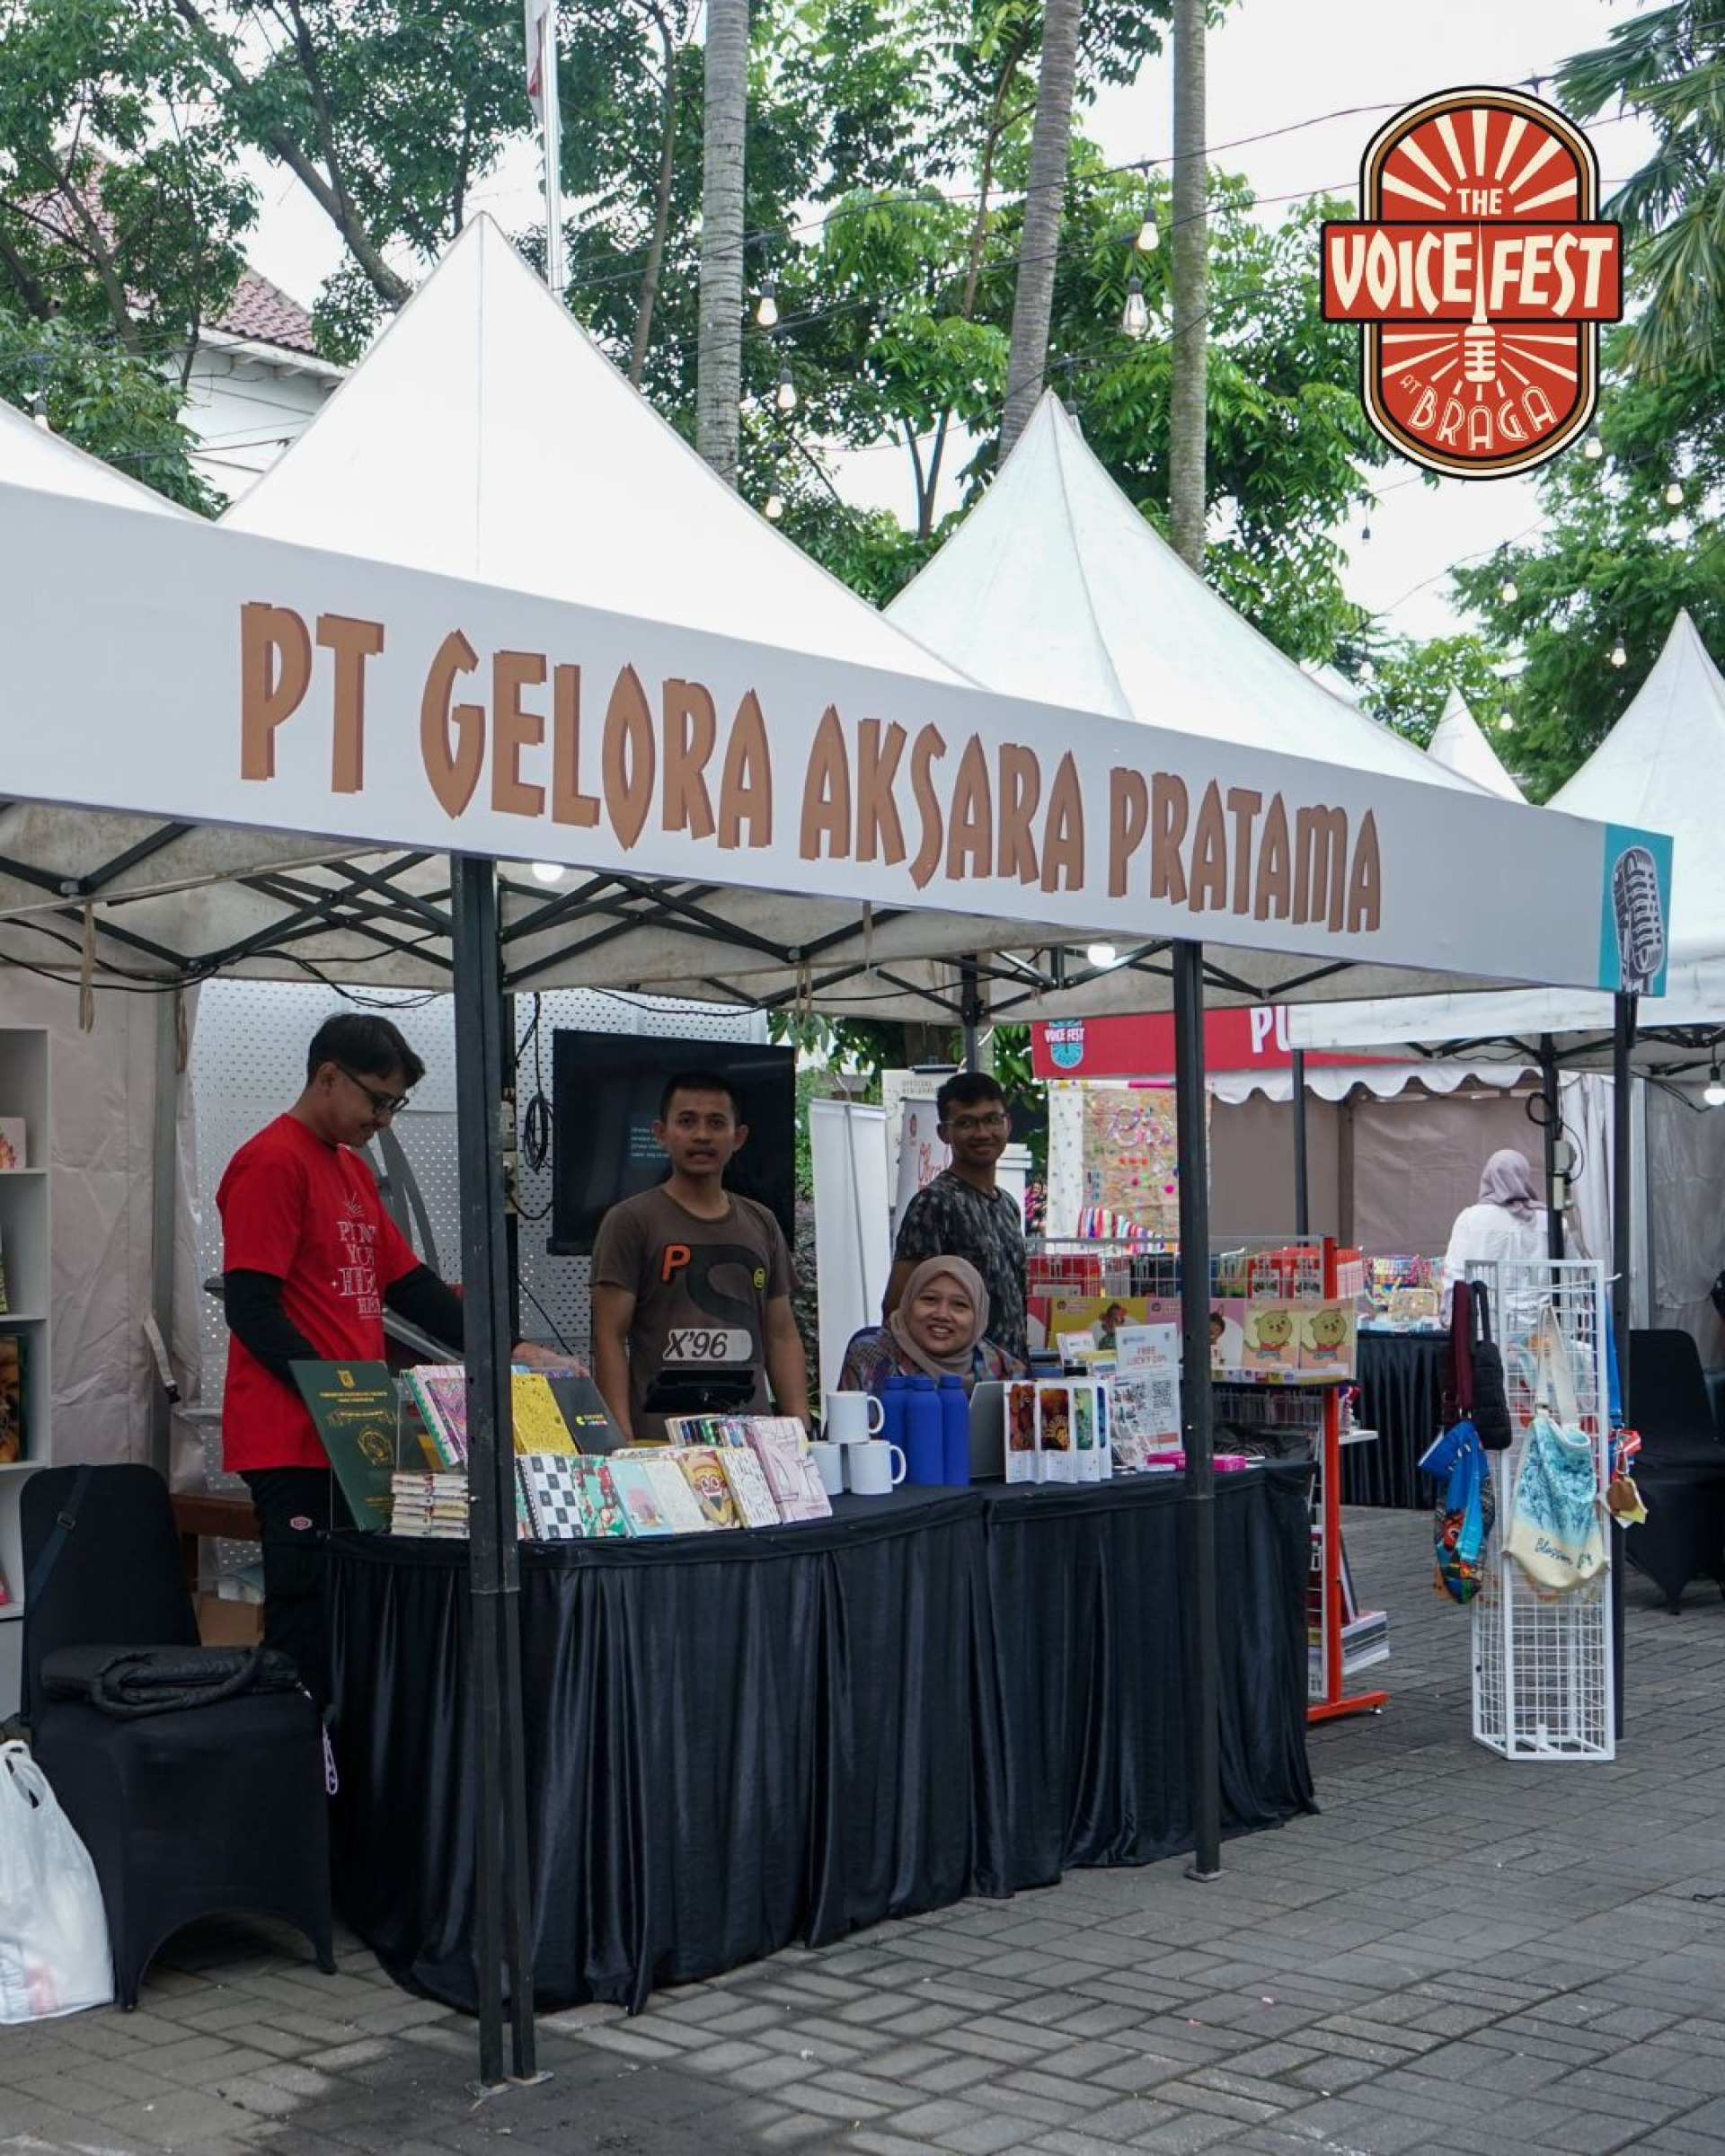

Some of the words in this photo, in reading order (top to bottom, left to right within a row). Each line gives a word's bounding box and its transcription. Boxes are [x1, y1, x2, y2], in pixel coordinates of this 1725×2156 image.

[240, 601, 385, 793] PT
[420, 628, 773, 852] GELORA
[799, 702, 1084, 893] AKSARA
[1108, 765, 1381, 932] PRATAMA
